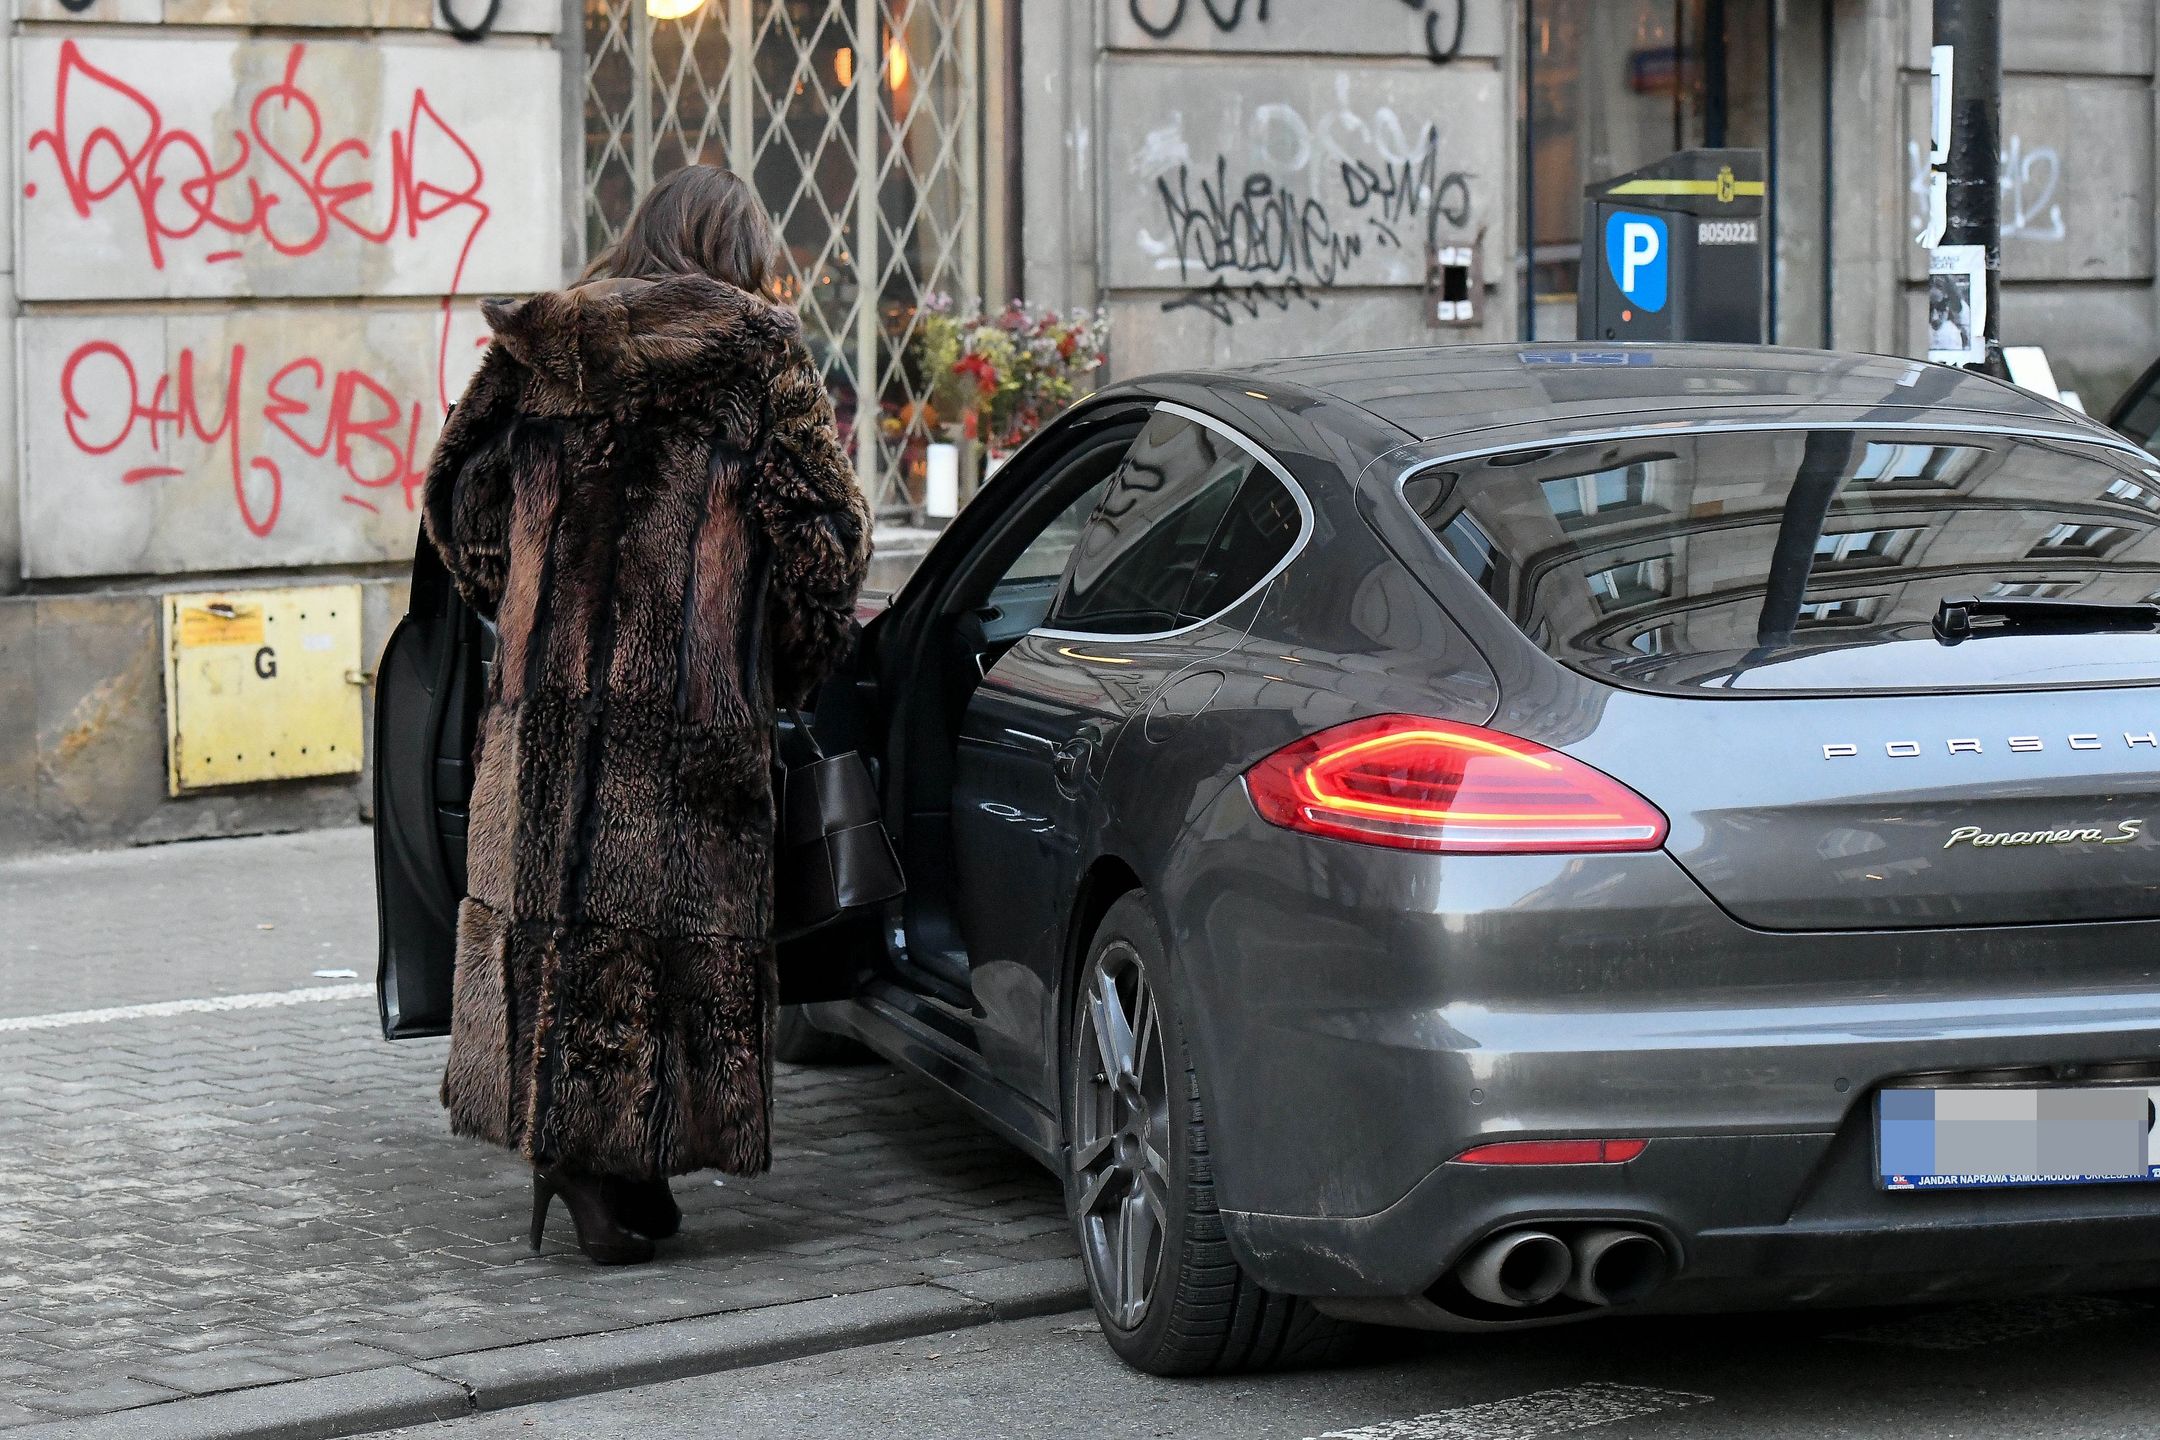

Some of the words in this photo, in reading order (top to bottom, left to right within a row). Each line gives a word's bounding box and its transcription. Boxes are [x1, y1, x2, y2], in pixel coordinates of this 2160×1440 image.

[1623, 223, 1659, 293] P
[255, 646, 277, 680] G
[1822, 731, 2158, 760] PORSCH
[1943, 826, 2102, 849] Panamera
[2102, 819, 2143, 844] S
[1918, 1176, 1958, 1185] JANDAR
[1959, 1174, 2008, 1184] NAPRAWA
